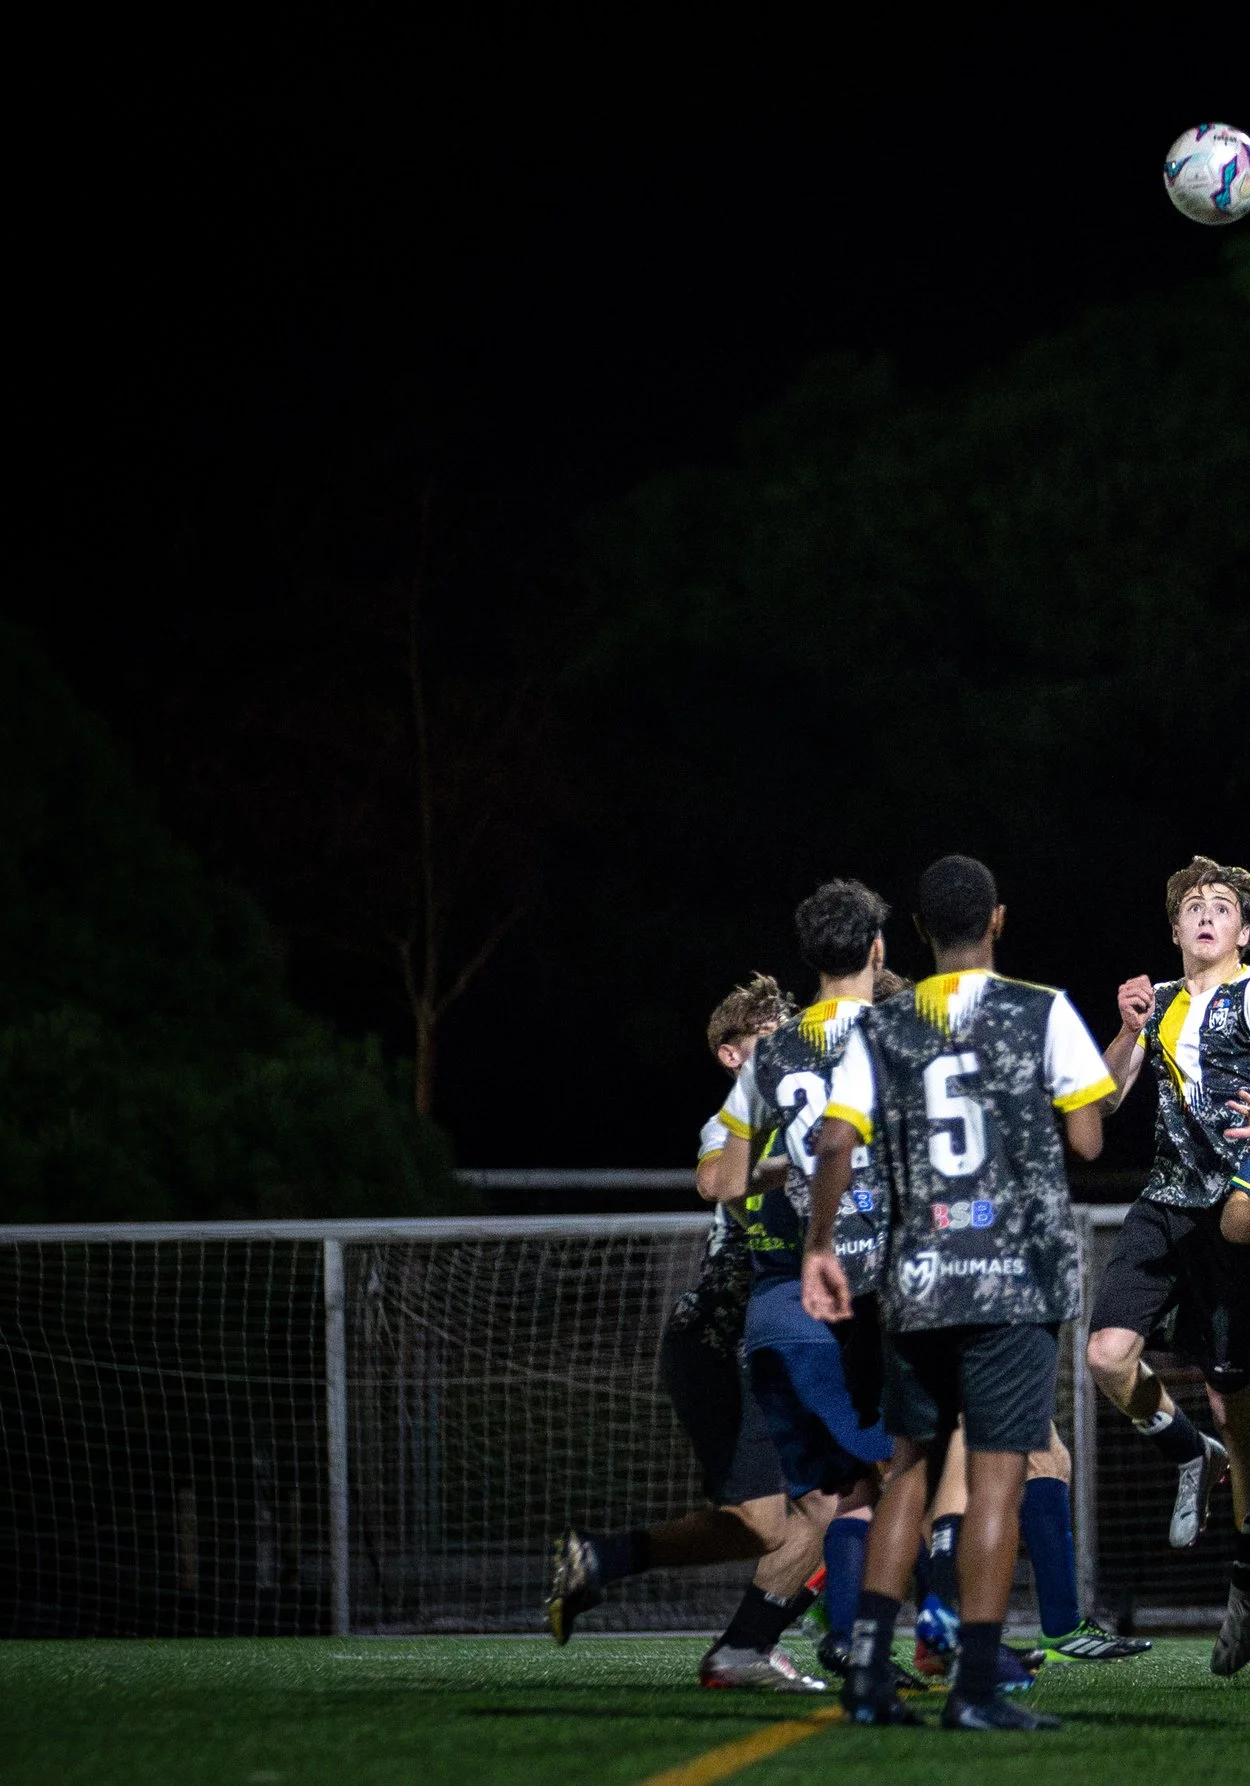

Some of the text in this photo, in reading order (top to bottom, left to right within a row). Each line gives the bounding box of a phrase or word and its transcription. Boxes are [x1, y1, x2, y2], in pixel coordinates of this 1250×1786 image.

[923, 1052, 987, 1178] 5
[931, 1200, 995, 1230] BSB
[940, 1258, 1026, 1276] HUMAES
